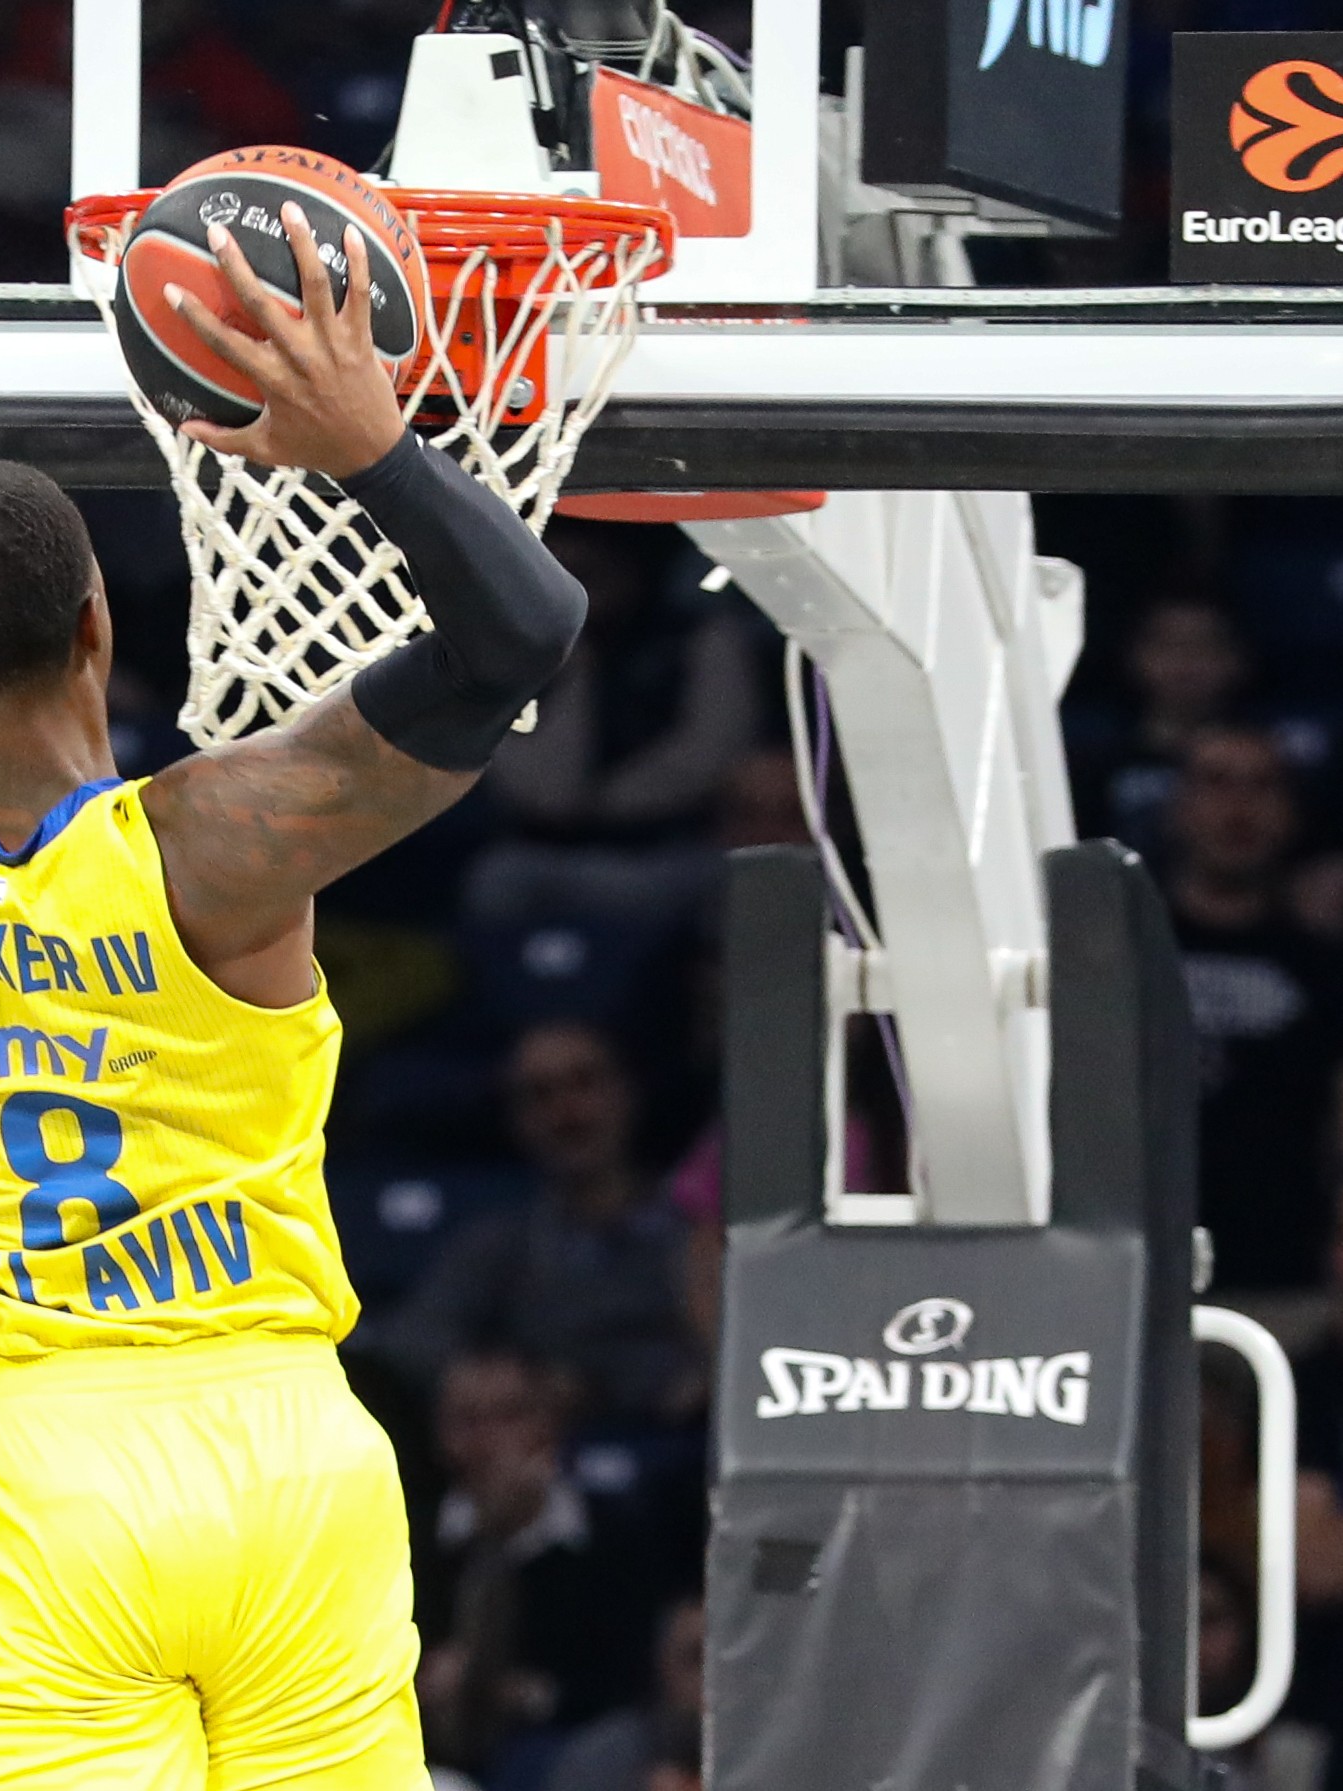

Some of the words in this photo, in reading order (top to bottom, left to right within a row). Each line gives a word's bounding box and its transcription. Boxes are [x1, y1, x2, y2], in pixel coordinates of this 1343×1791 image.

[91, 931, 159, 995] IV
[108, 1049, 158, 1074] GROUP
[0, 1091, 141, 1250] 8
[82, 1200, 253, 1312] AVIV
